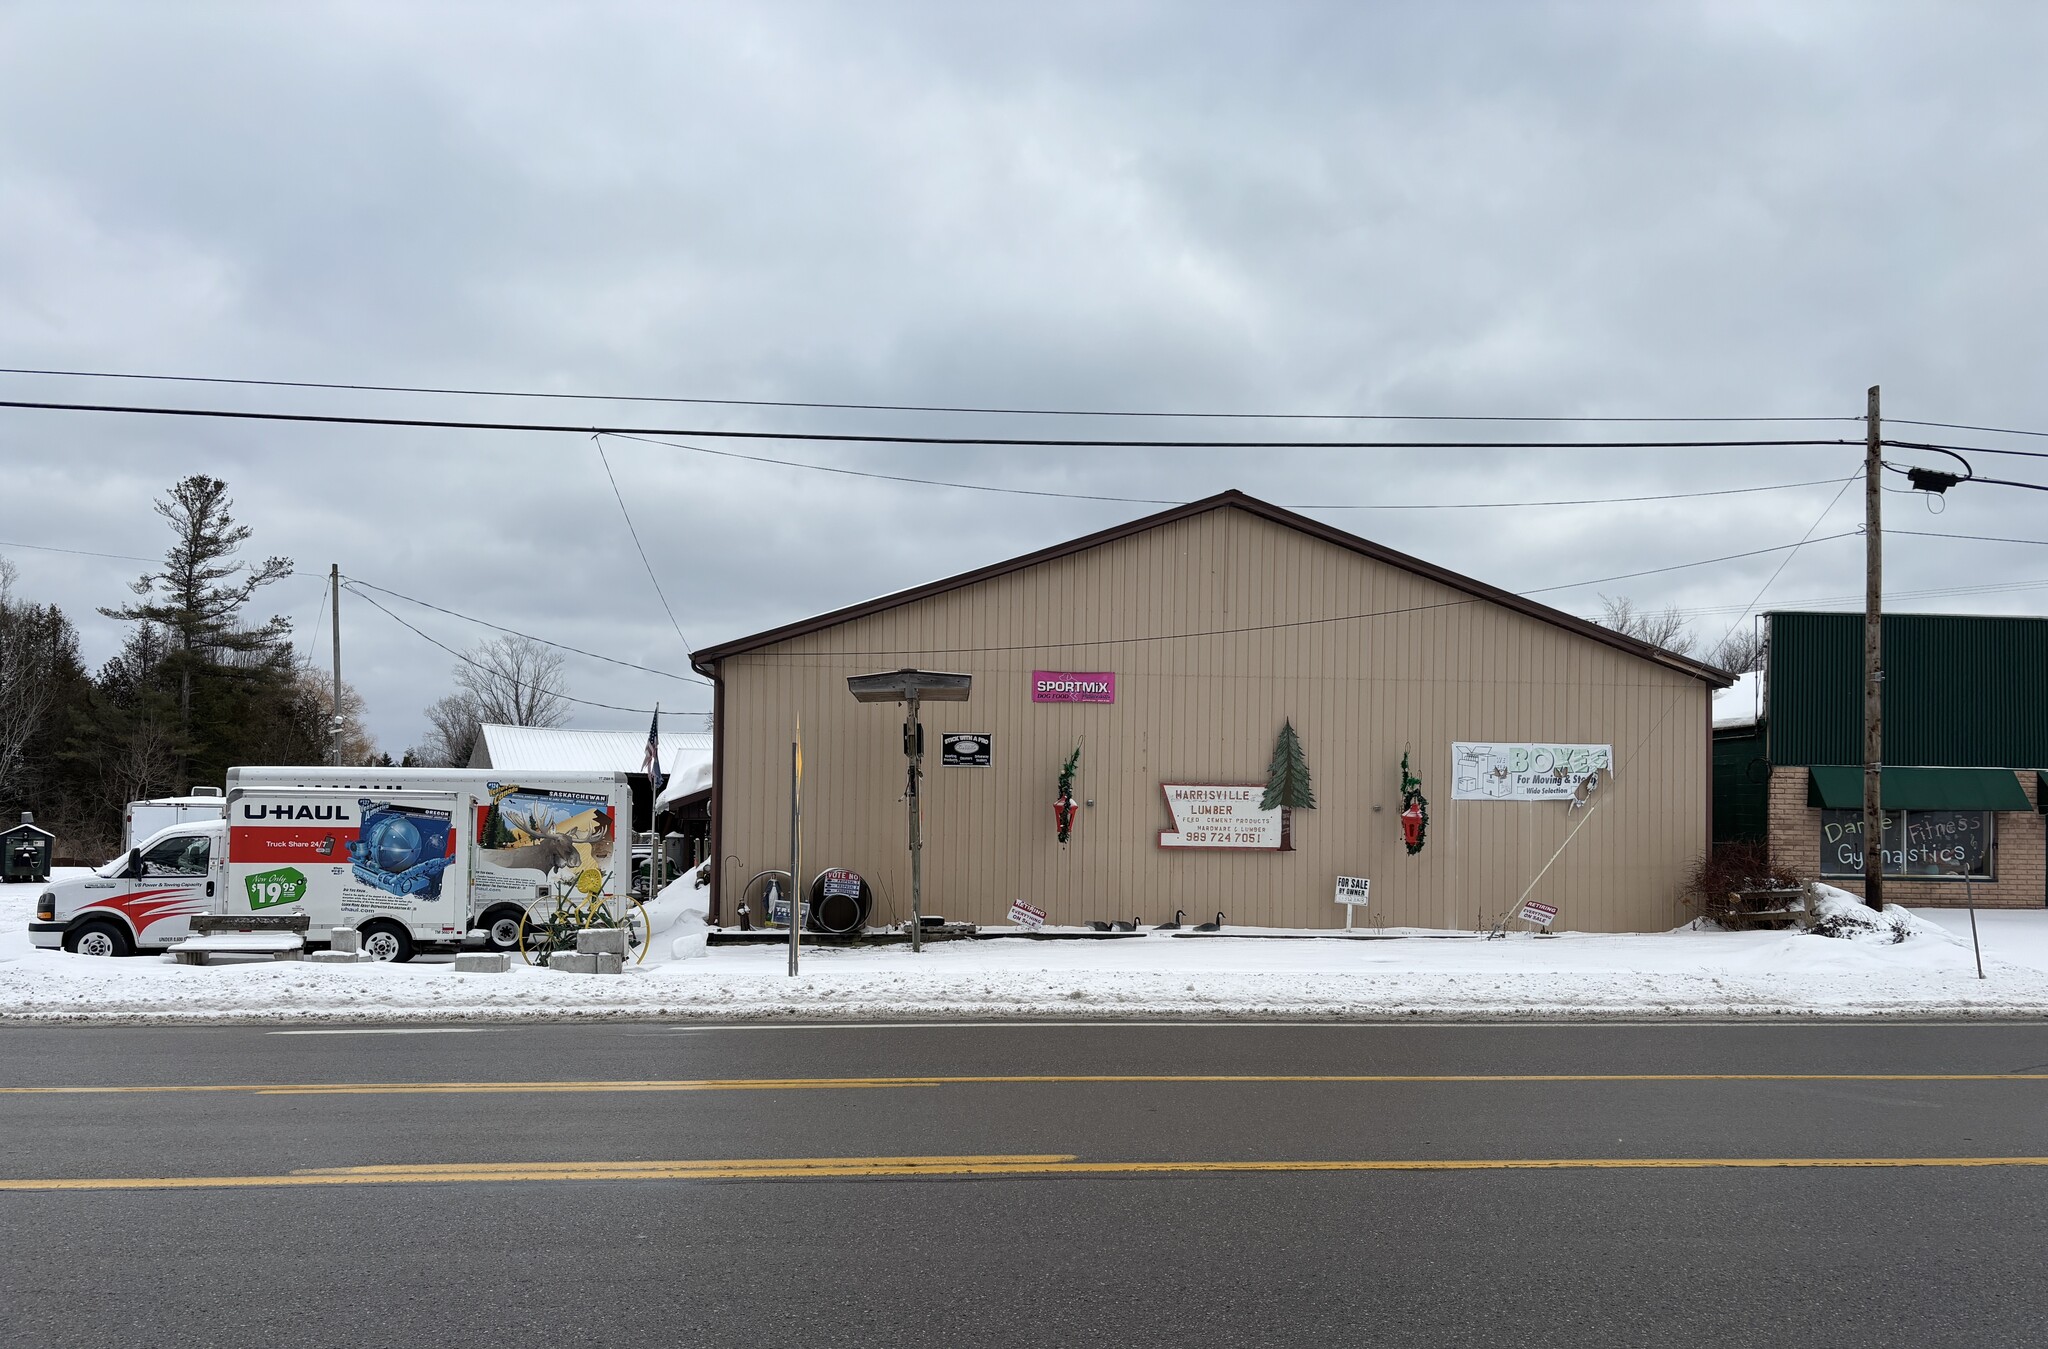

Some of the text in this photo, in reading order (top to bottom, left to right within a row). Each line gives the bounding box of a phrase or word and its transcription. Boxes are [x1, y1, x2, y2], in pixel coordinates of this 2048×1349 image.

[944, 735, 959, 744] STICK
[978, 736, 989, 745] PRO
[1517, 774, 1530, 784] For
[1532, 774, 1562, 786] Moving
[1564, 774, 1571, 784] &
[548, 790, 607, 801] SASKATCHEWAN
[1175, 789, 1250, 801] HARRISVILLE
[244, 804, 350, 820] U-HAUL
[425, 809, 449, 817] OREGON
[1191, 805, 1233, 815] LUMBER
[1824, 816, 1981, 845] Dane Fitness
[1186, 832, 1261, 843] 989 724 7051
[266, 840, 328, 848] Truck Share 24/7
[1837, 843, 1966, 871] Gynastics
[252, 873, 287, 885] Now Only
[828, 871, 847, 879] VOTE
[1337, 877, 1369, 890] FOR SALE
[1346, 888, 1366, 896] OWNER
[776, 906, 806, 915] TRP
[1015, 899, 1046, 917] RETIRING
[1527, 901, 1557, 913] RETIRING
[1011, 908, 1042, 924] EVERYTHING
[1523, 908, 1552, 920] EVERYTHING
[1022, 918, 1036, 927] SALE
